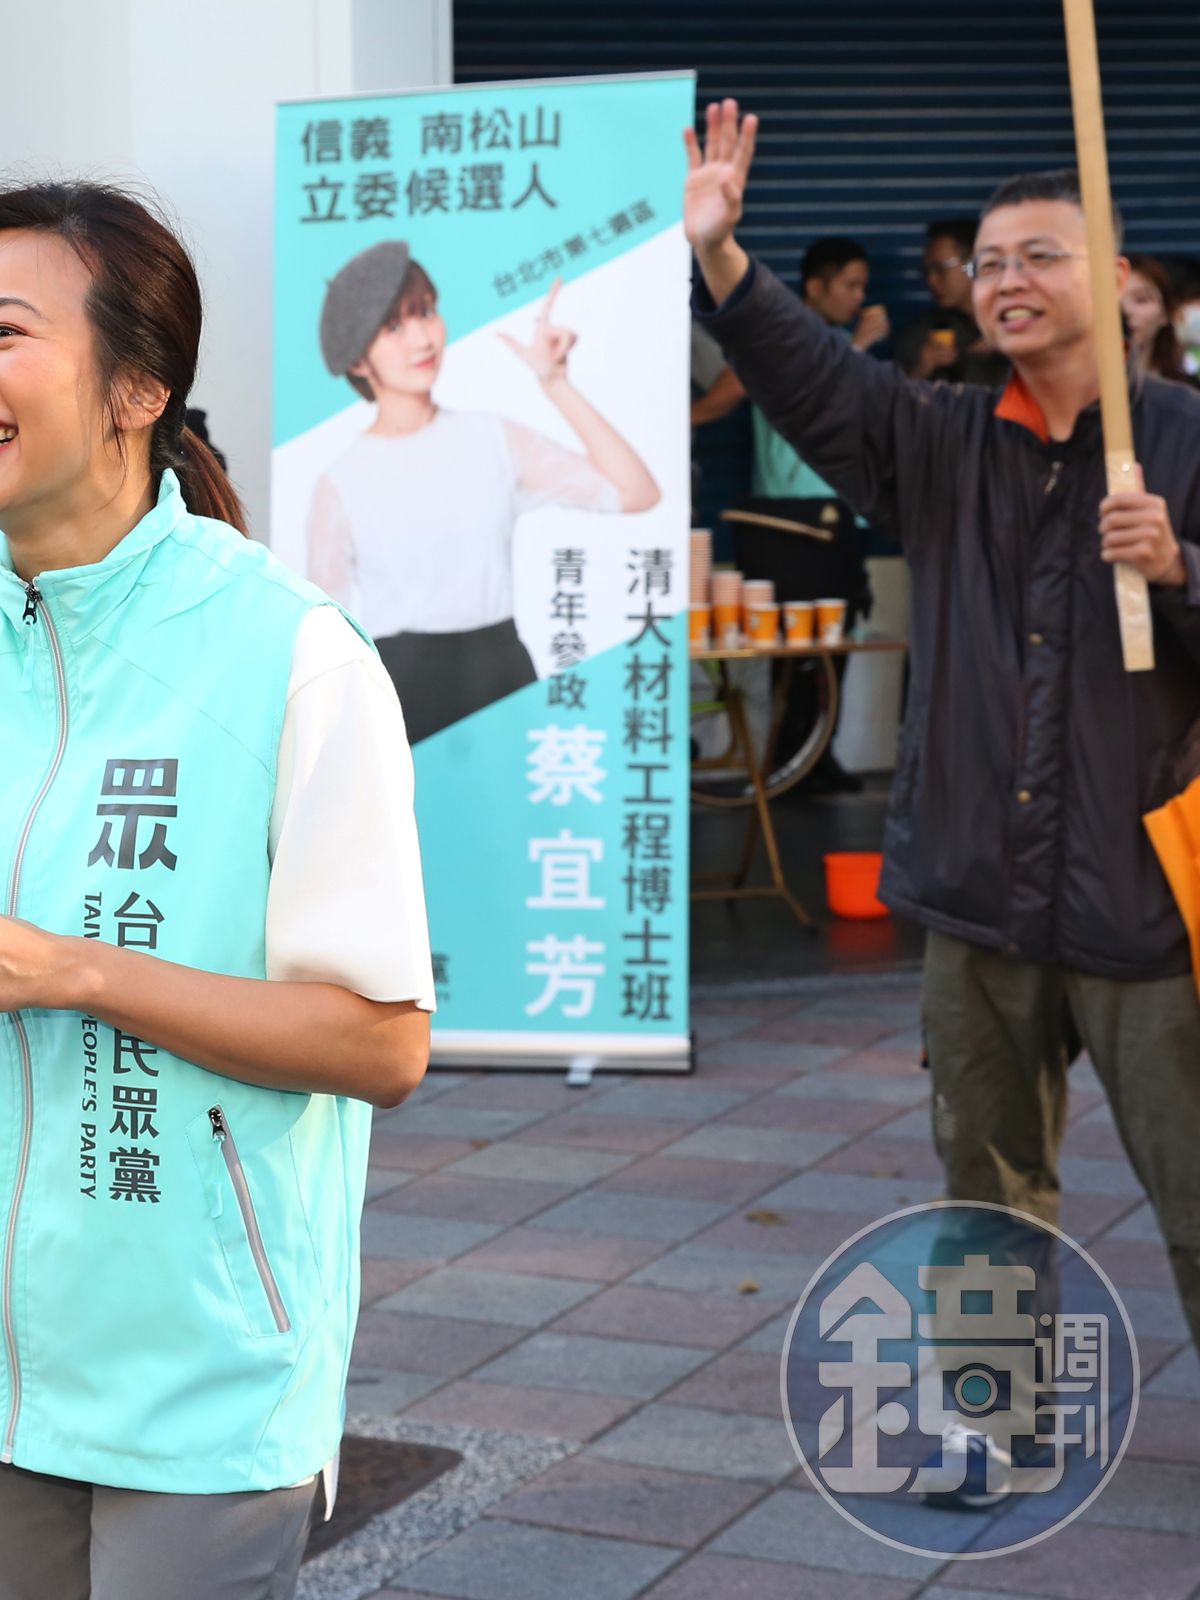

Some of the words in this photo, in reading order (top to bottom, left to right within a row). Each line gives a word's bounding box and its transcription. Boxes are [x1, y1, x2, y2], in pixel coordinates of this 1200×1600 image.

[301, 116, 392, 164] 信義
[420, 105, 563, 156] 南松山
[299, 162, 559, 223] 立委候選人
[493, 197, 655, 298] 台北市第七選區
[547, 547, 588, 711] 青年參政
[621, 547, 674, 1022] 清大材料工程博士班
[525, 724, 607, 1018] 蔡宜芳
[81, 1013, 98, 1112] EOPLE'S
[108, 891, 165, 1204] 台民眾黨
[80, 1122, 97, 1200] PARTY
